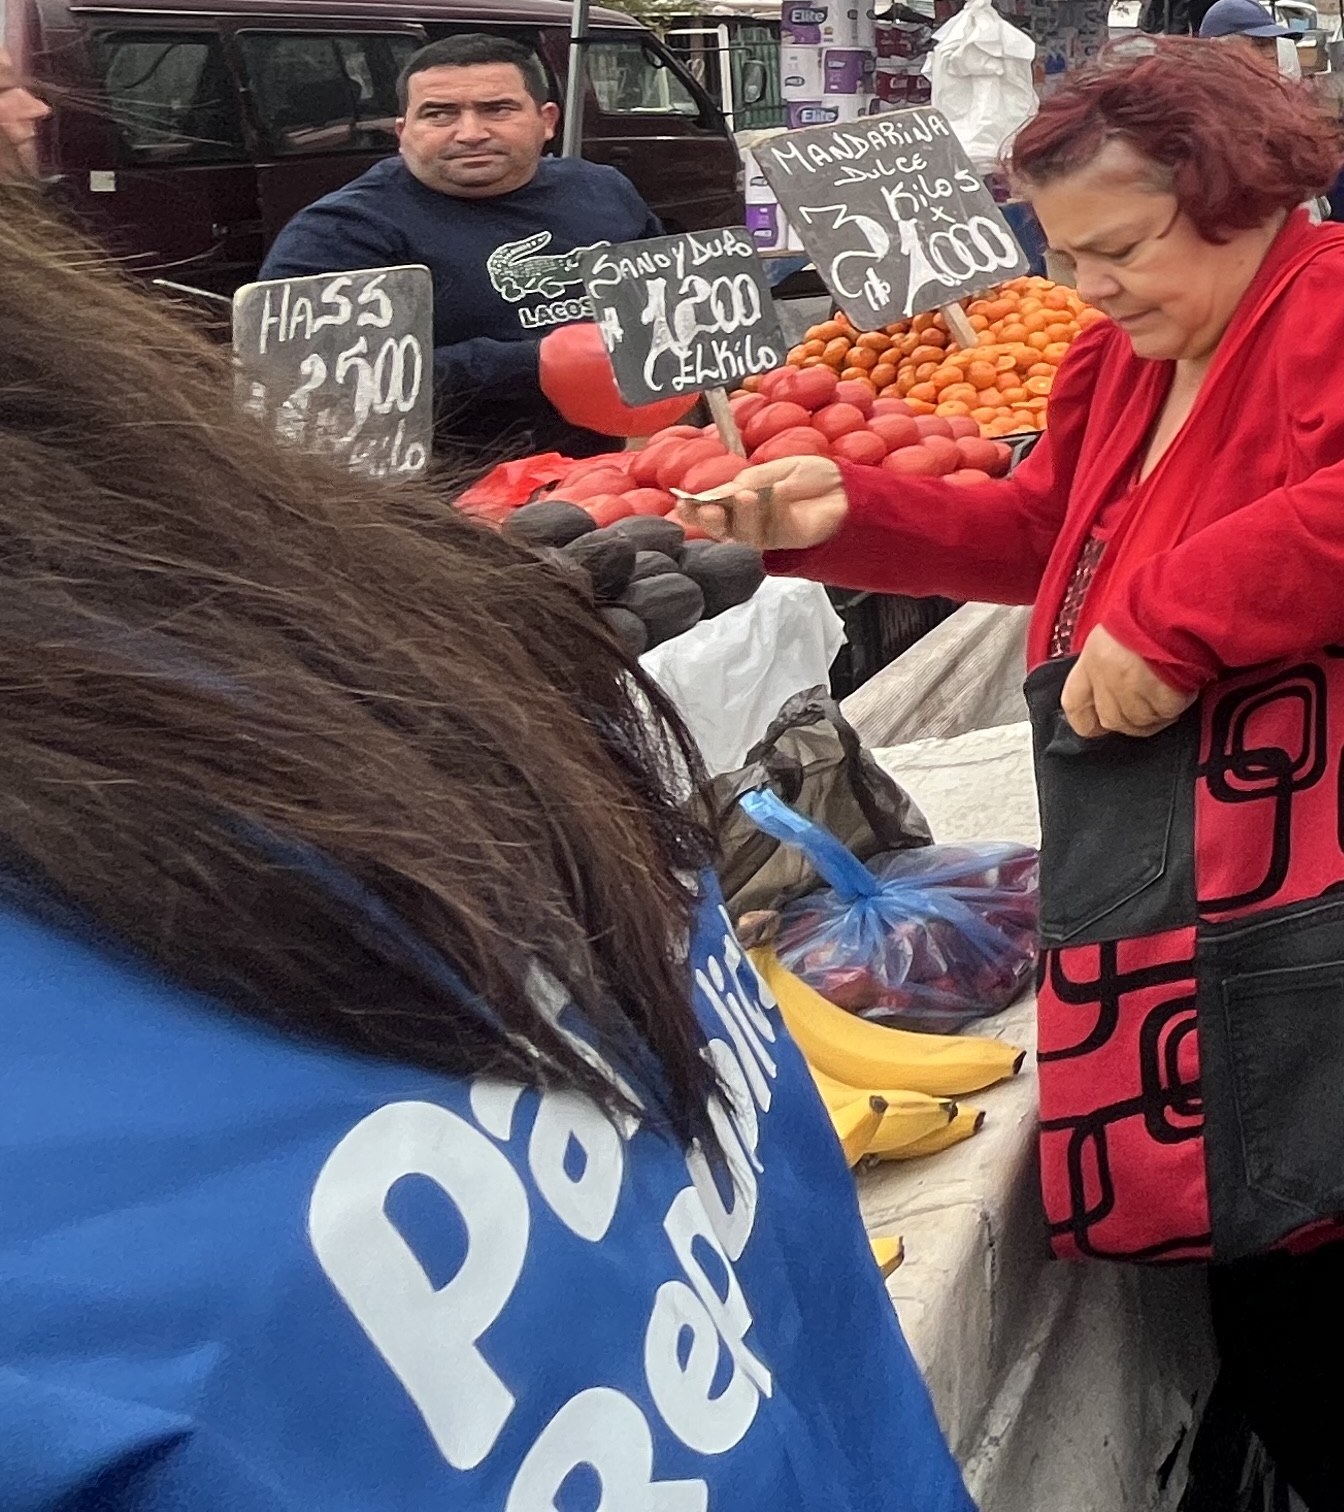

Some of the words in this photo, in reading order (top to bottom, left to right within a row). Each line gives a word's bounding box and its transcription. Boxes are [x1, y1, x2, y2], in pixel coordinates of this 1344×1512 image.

[791, 8, 825, 22] Elite
[801, 109, 837, 123] Elite
[799, 204, 890, 298] 3
[259, 274, 394, 355] HASS
[642, 274, 761, 376] 1200
[280, 334, 423, 441] 2500
[504, 904, 778, 1512] Republic
